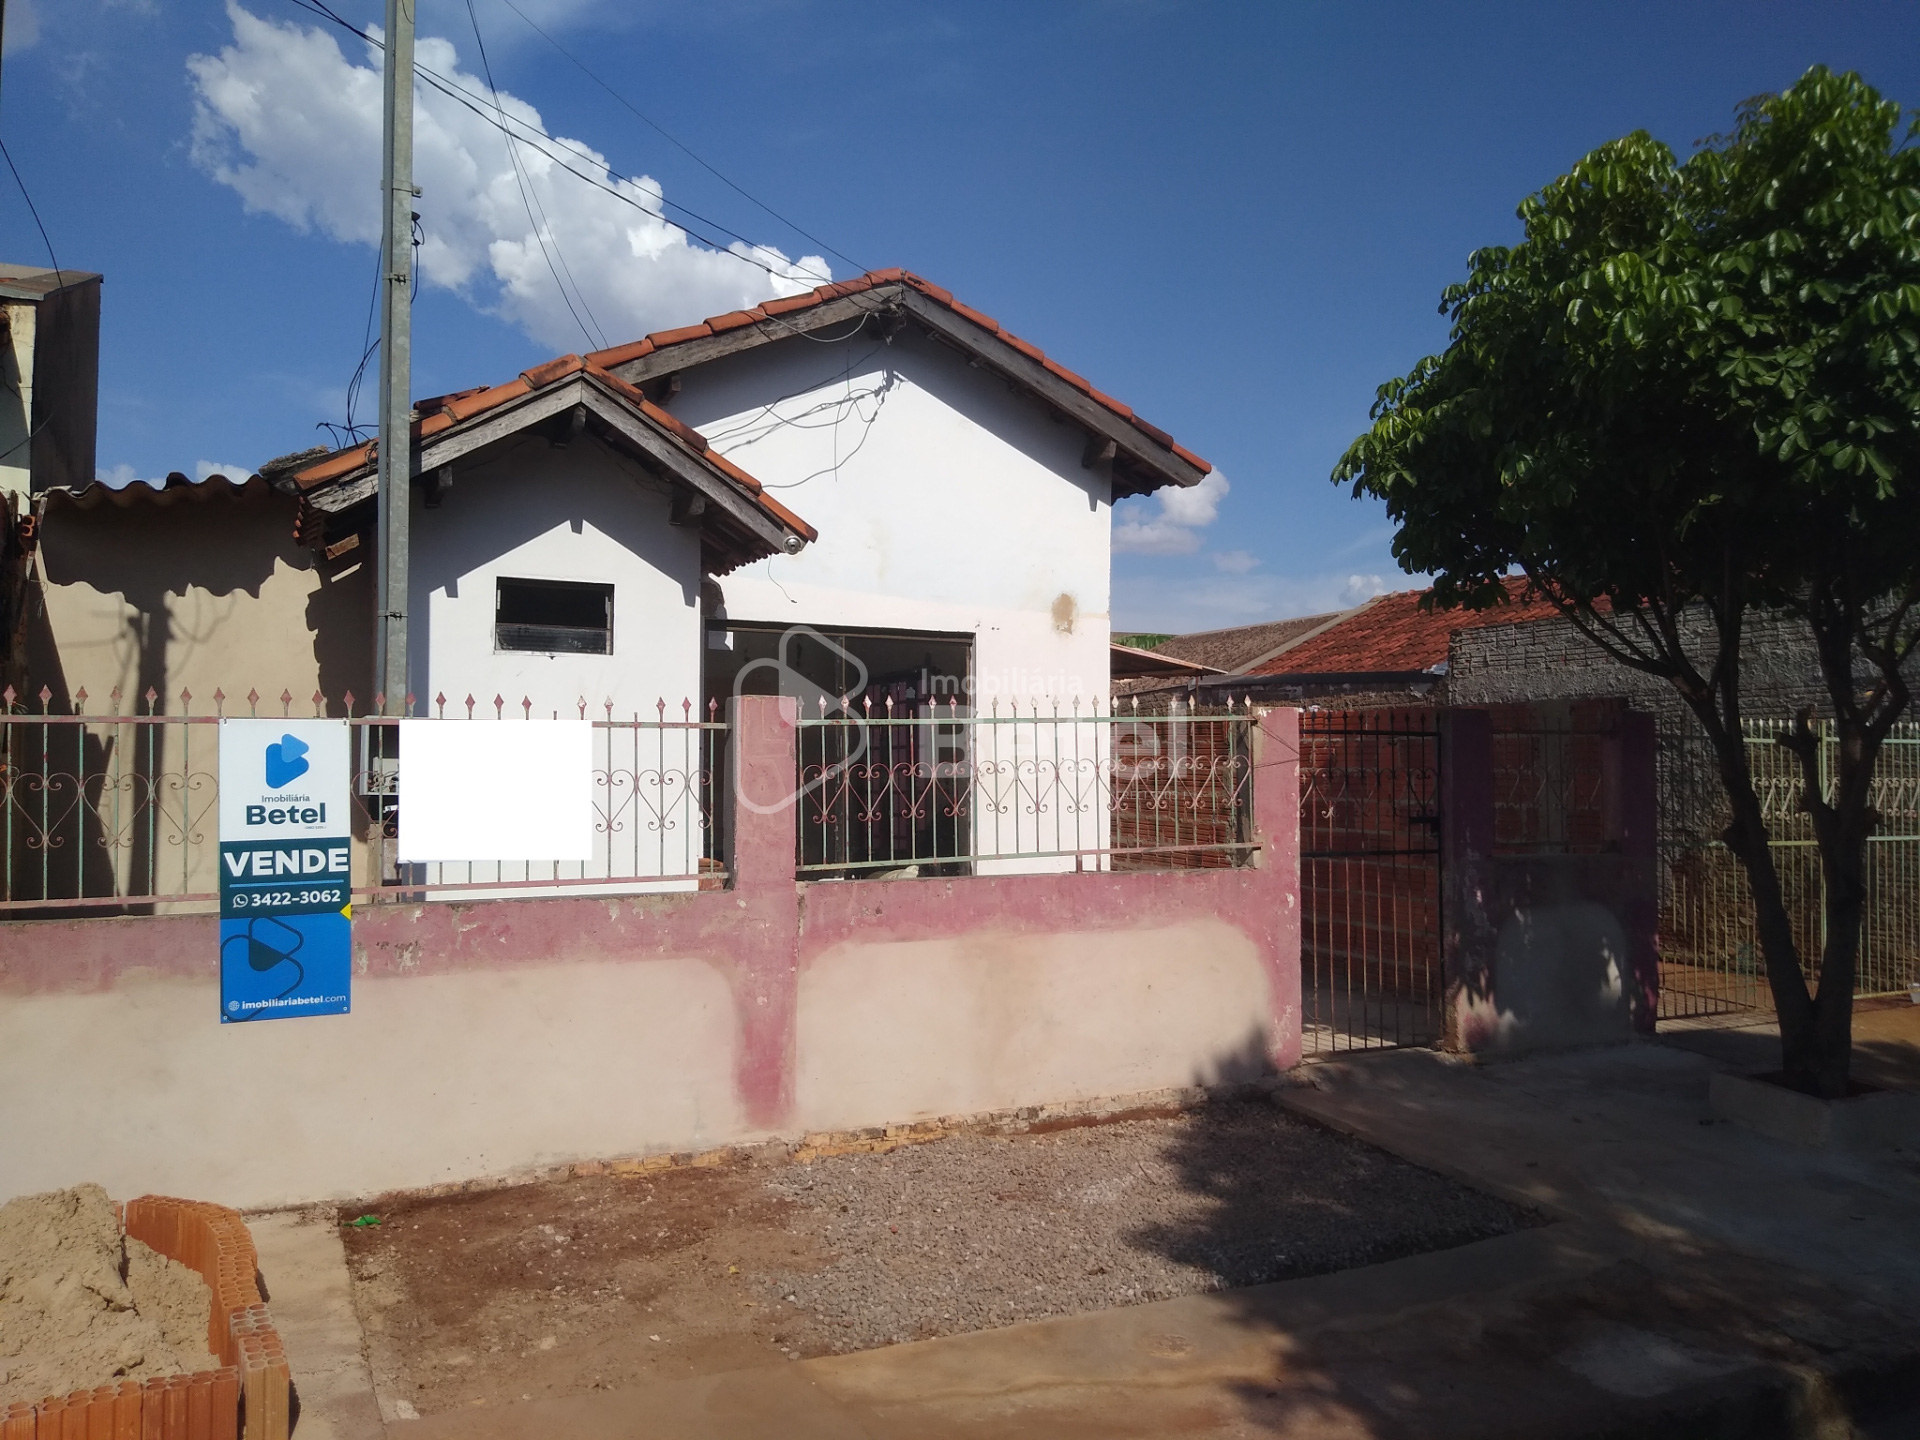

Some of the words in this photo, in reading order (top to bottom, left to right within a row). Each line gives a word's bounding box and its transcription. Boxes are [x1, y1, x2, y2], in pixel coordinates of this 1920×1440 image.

[261, 794, 311, 803] Imobiliária
[246, 802, 326, 826] Betel
[223, 847, 349, 877] VENDE
[251, 889, 341, 907] 3422-3062
[241, 995, 346, 1010] imobiliariabetel.com
